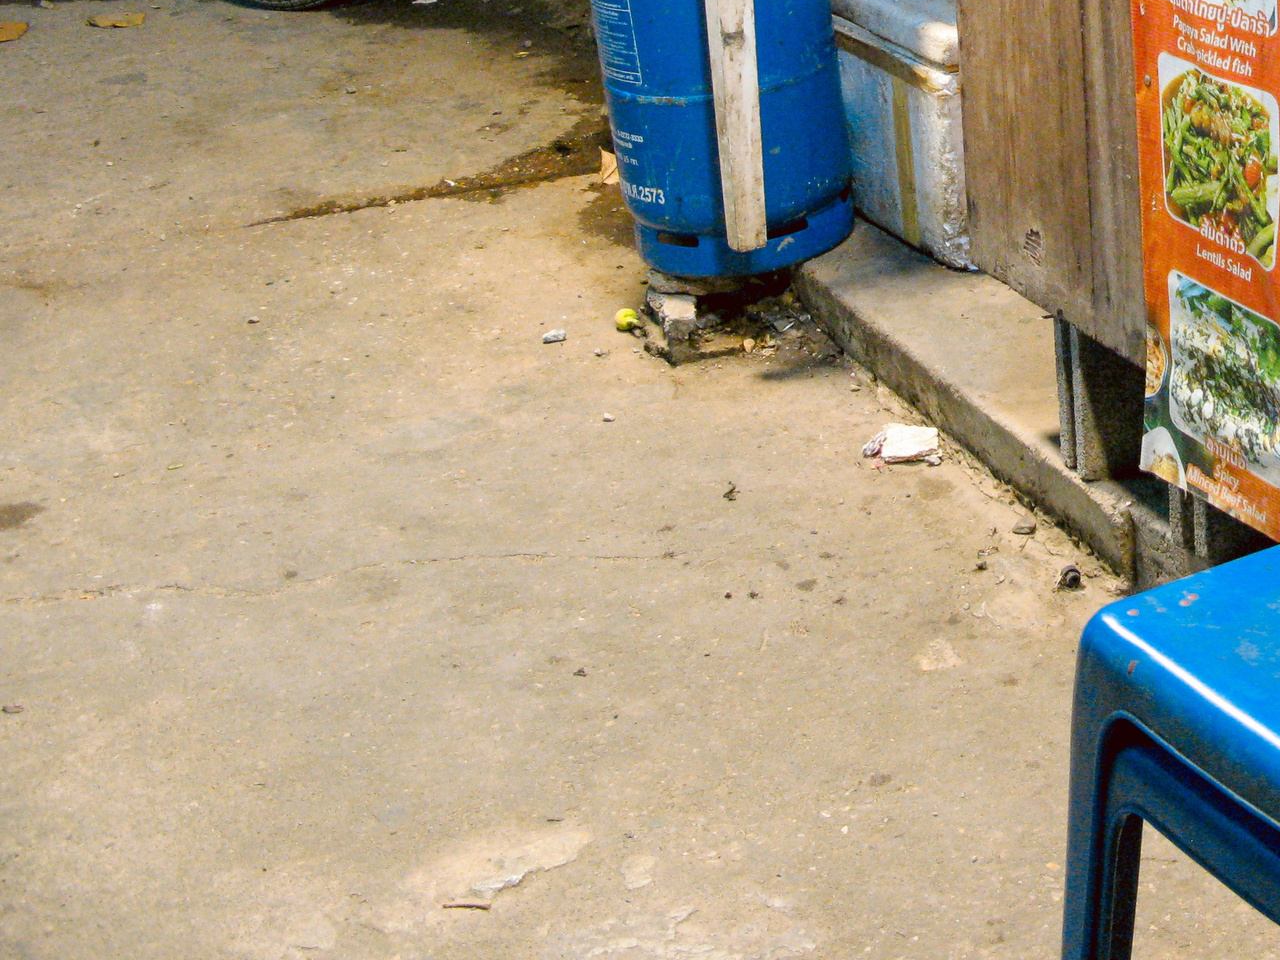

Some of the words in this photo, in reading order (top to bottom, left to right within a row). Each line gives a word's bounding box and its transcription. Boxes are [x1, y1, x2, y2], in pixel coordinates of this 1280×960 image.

[1173, 14, 1198, 40] Papaya
[1200, 28, 1228, 49] Salad
[1230, 36, 1257, 58] With
[1232, 58, 1252, 77] fish
[1200, 216, 1246, 255] ส้มตำถั่ว
[1196, 243, 1226, 269] Lentils
[1226, 258, 1252, 282] Salad
[1187, 466, 1221, 496] Minced
[1220, 485, 1243, 508] Beef
[1242, 499, 1267, 524] Salad
[1214, 463, 1239, 492] Spicy
